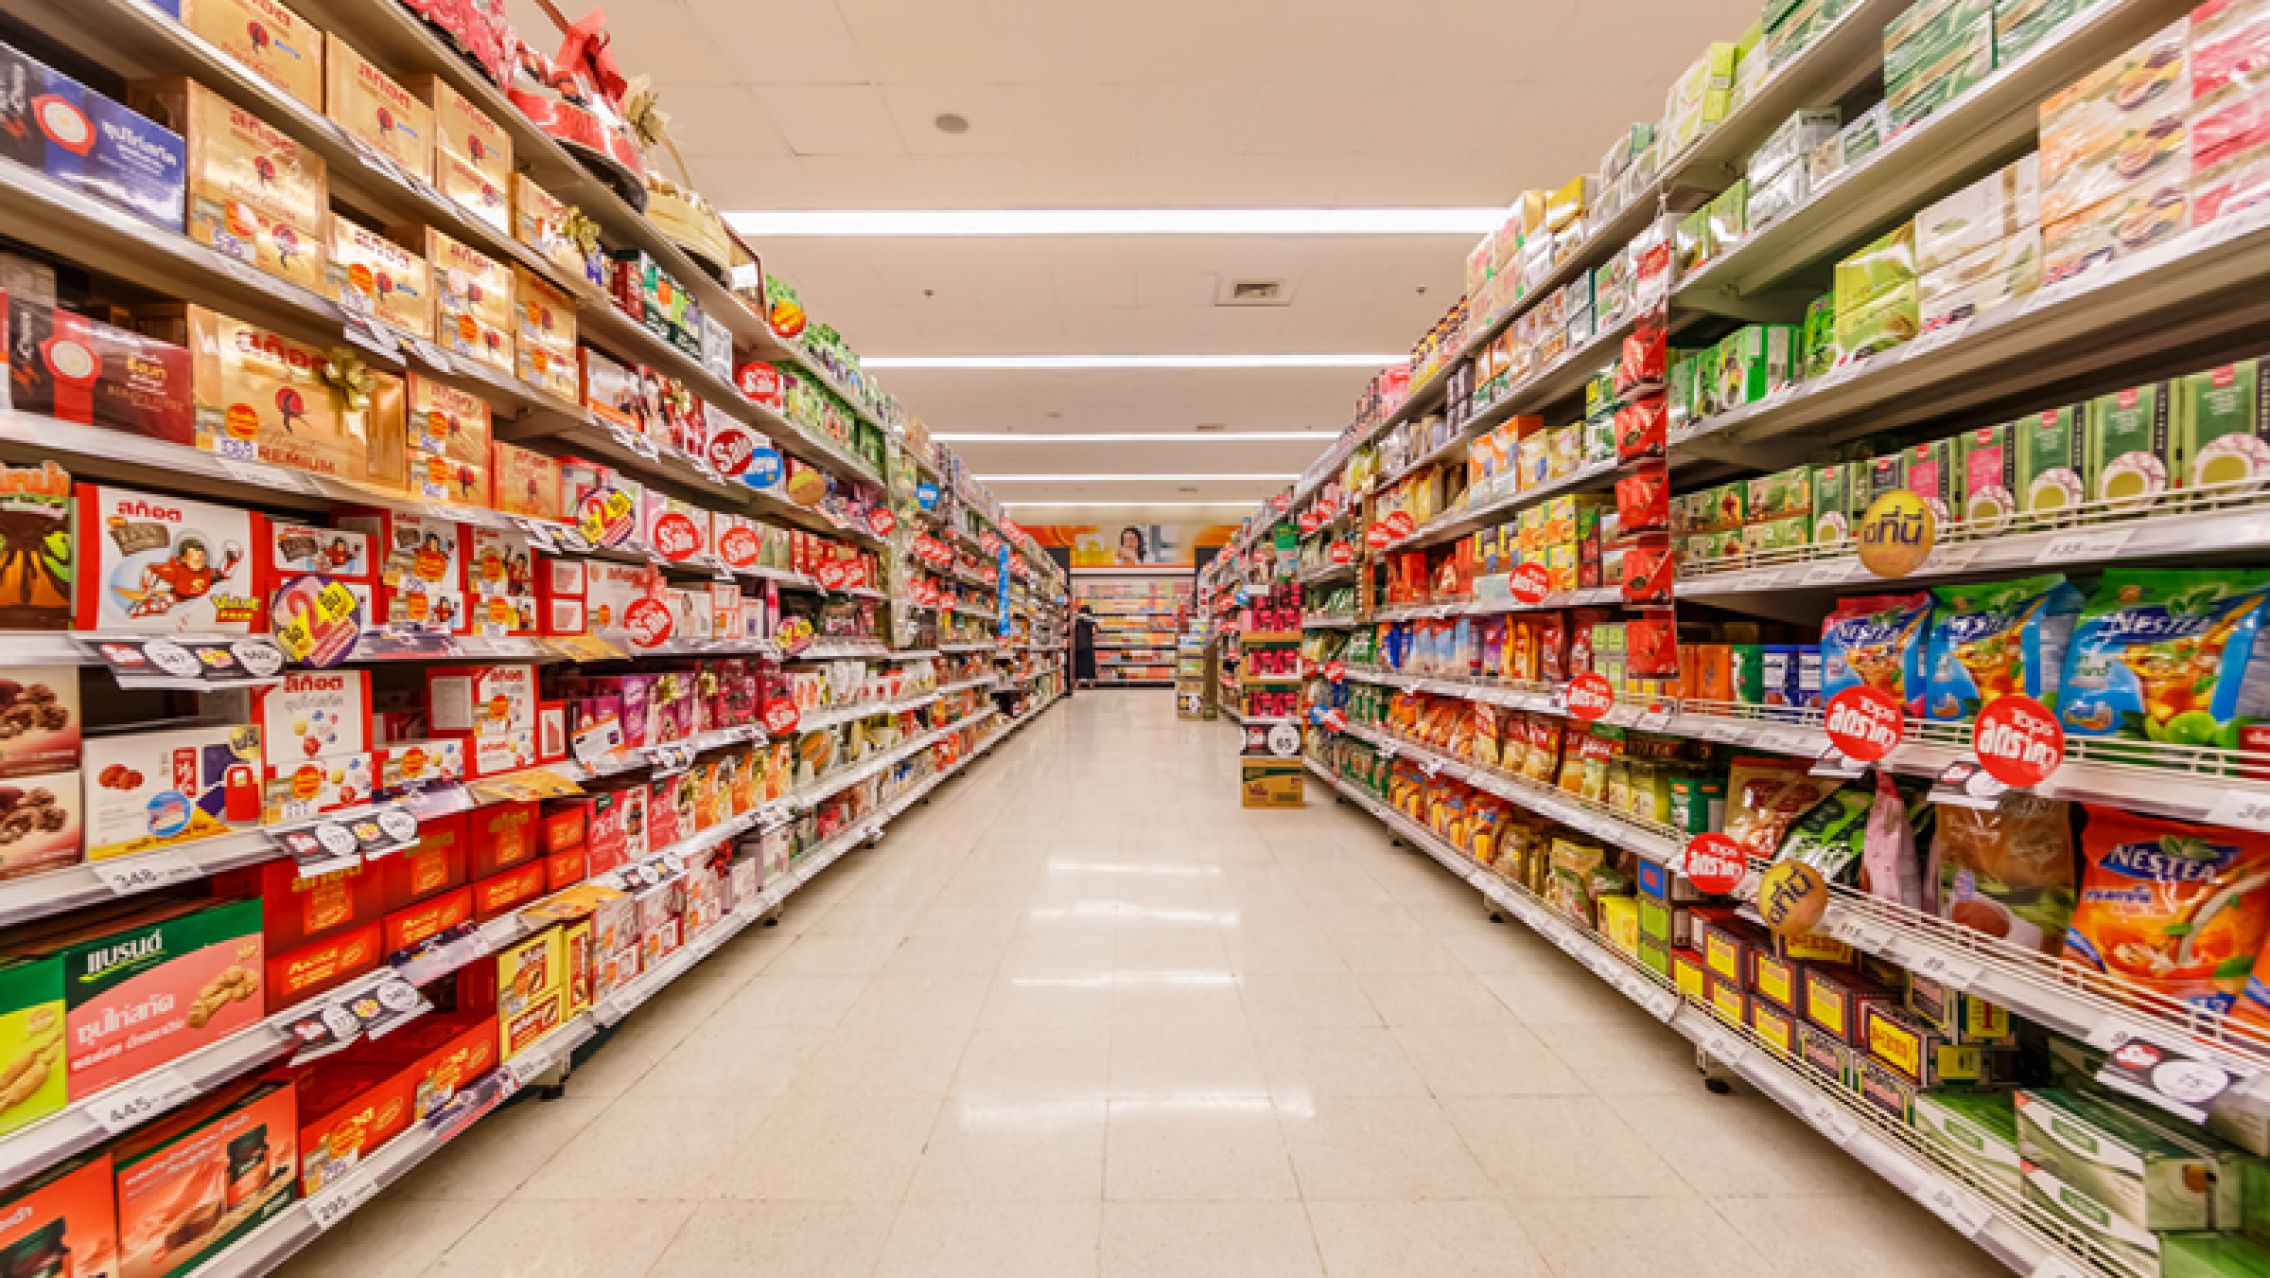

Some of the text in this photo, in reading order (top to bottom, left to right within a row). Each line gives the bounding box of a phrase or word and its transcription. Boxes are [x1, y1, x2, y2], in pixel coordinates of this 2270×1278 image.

[586, 496, 616, 529] 2
[285, 589, 331, 640] 2
[1828, 702, 1896, 749] ลดราคา
[1977, 718, 2057, 776] ลดราคา
[1689, 850, 1742, 883] ลดราคา
[2109, 842, 2217, 885] NESTEA
[87, 928, 164, 975] แบรนด์
[77, 993, 175, 1046] ซุปไก่สกัด
